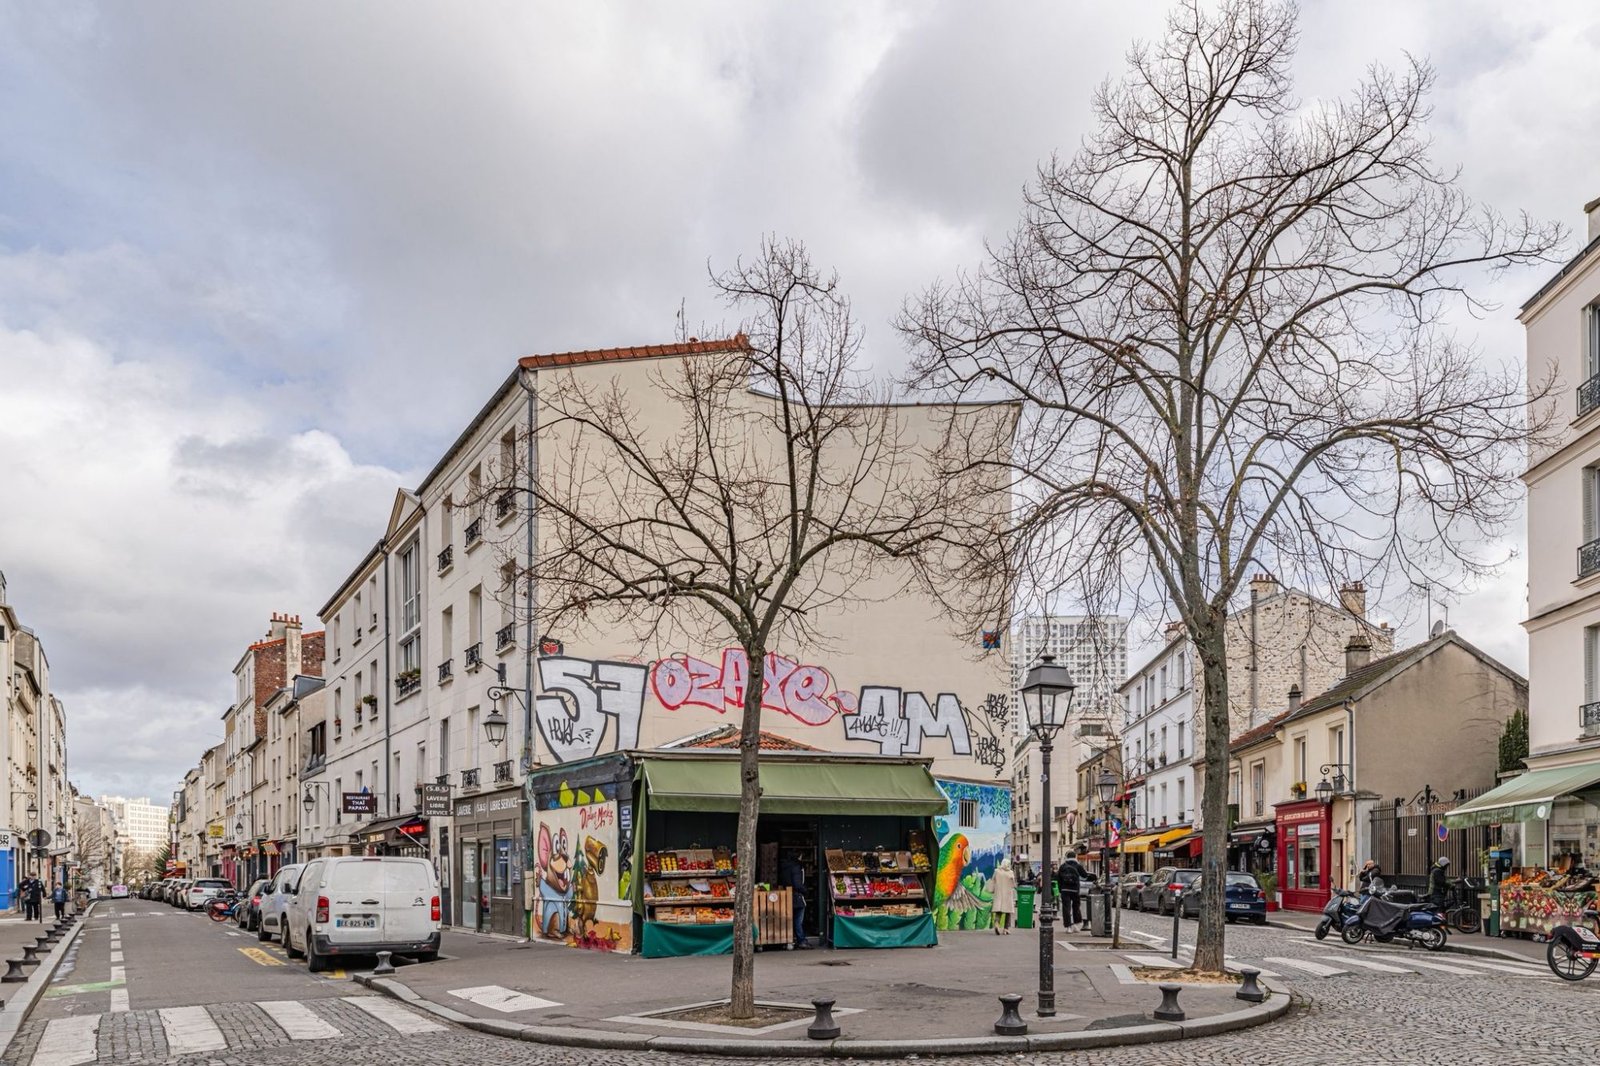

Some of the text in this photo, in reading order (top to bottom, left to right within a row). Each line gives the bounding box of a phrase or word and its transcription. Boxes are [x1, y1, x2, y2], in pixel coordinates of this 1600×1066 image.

[489, 799, 501, 811] LIBRE
[501, 796, 518, 809] SERVICE
[1504, 858, 1511, 868] P
